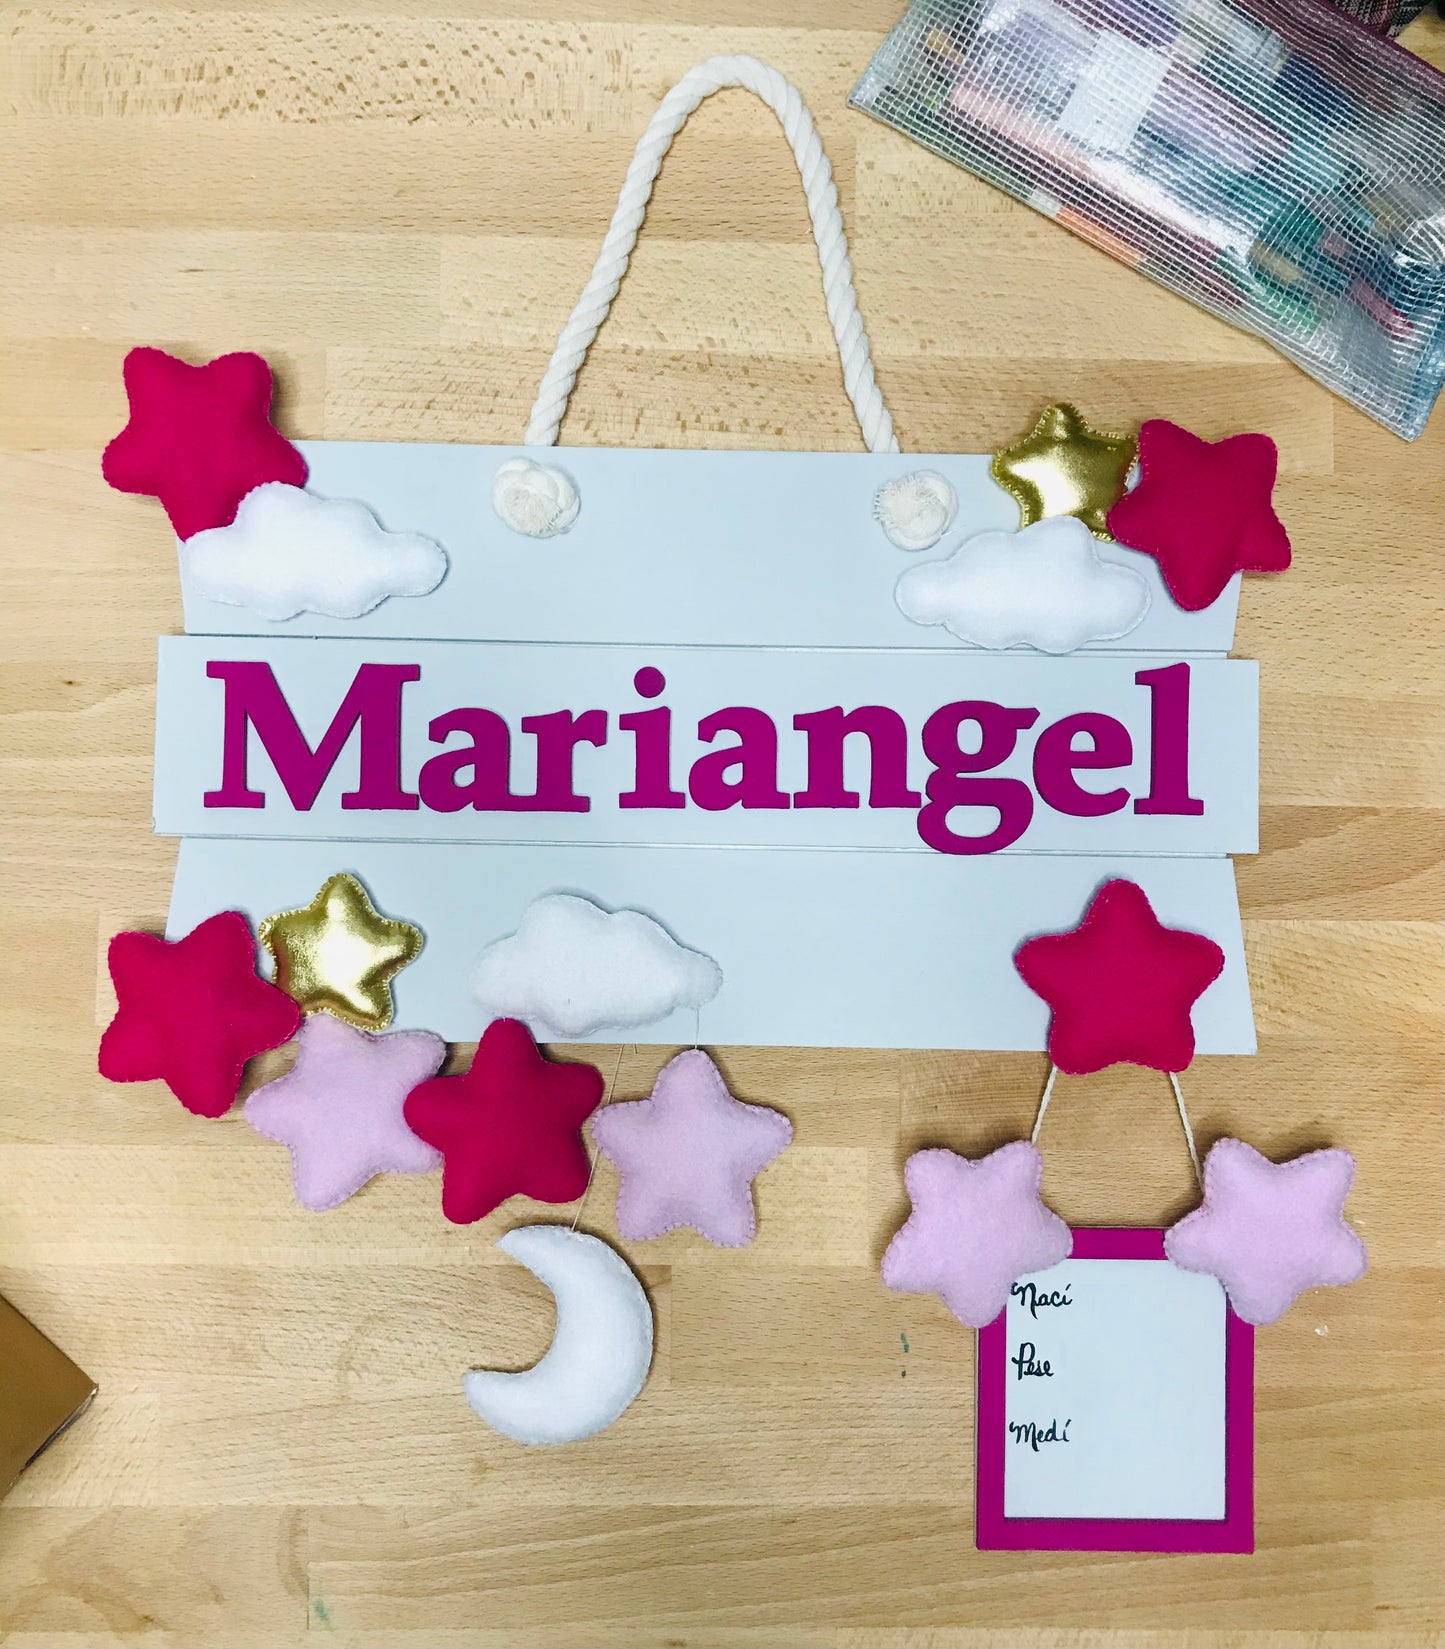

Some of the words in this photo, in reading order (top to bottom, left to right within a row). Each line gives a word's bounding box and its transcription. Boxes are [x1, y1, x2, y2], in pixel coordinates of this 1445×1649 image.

[203, 660, 1204, 855] Mariangel
[1010, 1281, 1073, 1320] Nací
[1011, 1341, 1054, 1381] Pese
[1008, 1418, 1072, 1452] Medí
